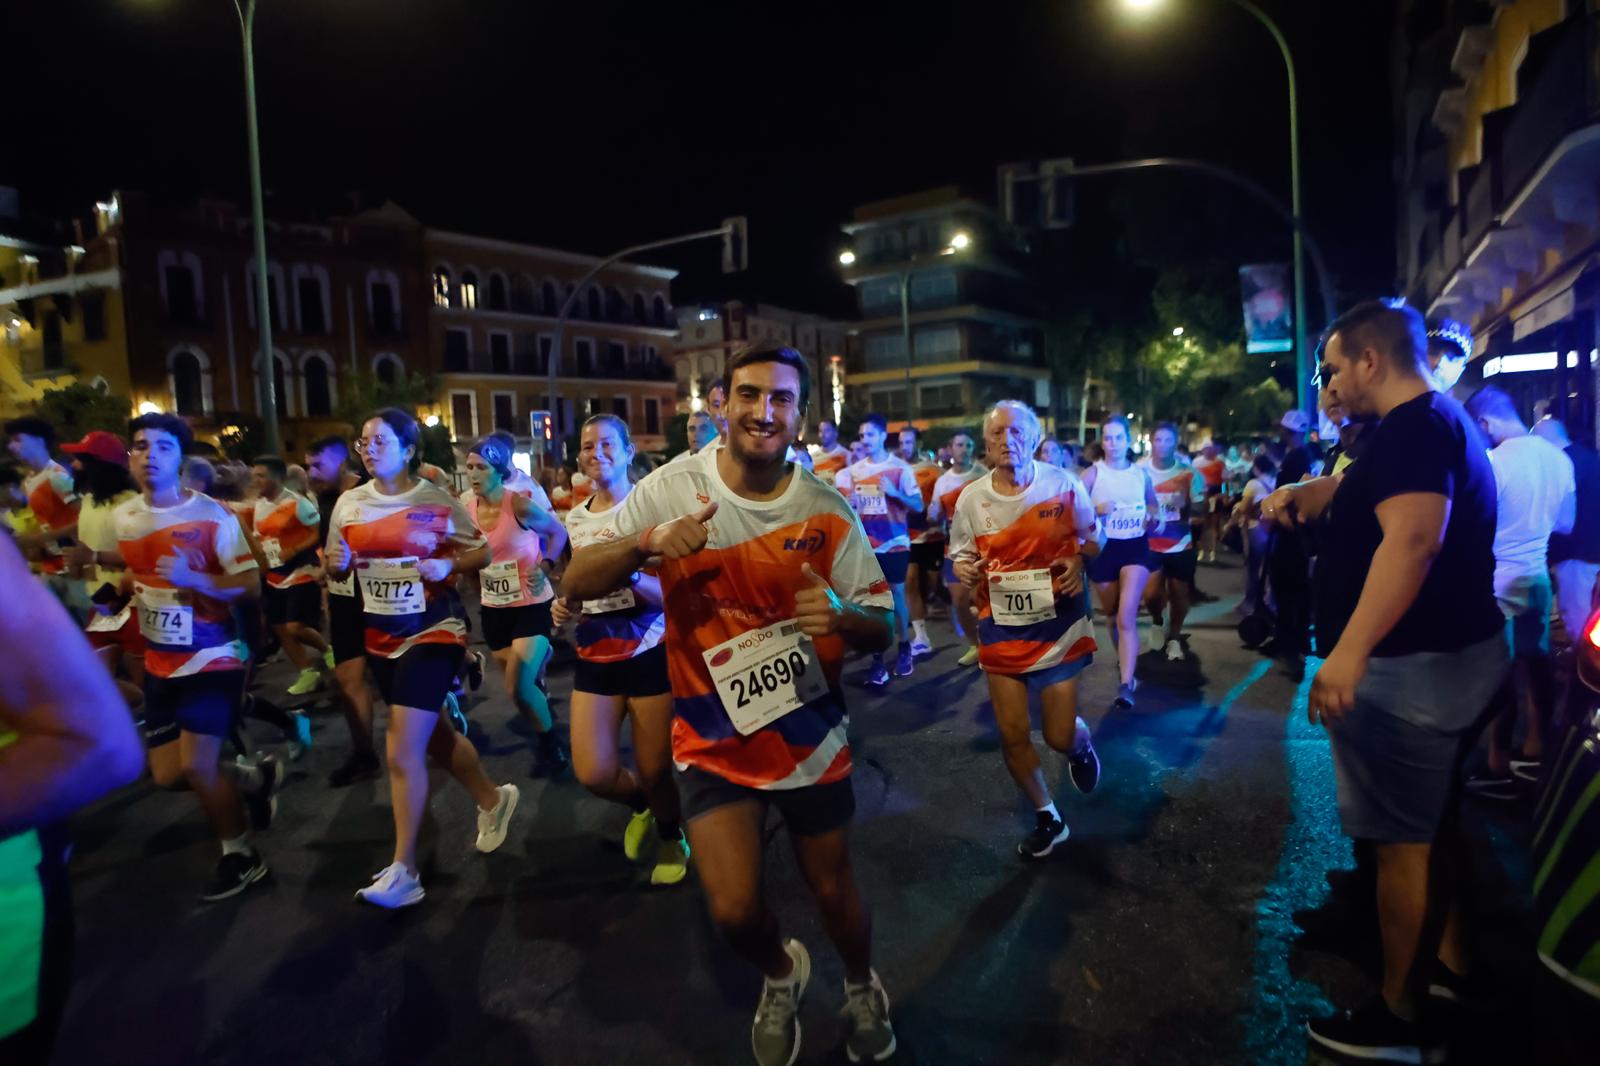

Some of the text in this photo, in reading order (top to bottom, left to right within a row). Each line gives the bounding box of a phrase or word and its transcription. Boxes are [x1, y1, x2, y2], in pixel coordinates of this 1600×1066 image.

[1112, 518, 1140, 530] 19934
[366, 580, 414, 598] 12772
[1004, 593, 1033, 611] 701
[730, 651, 806, 708] 24690
